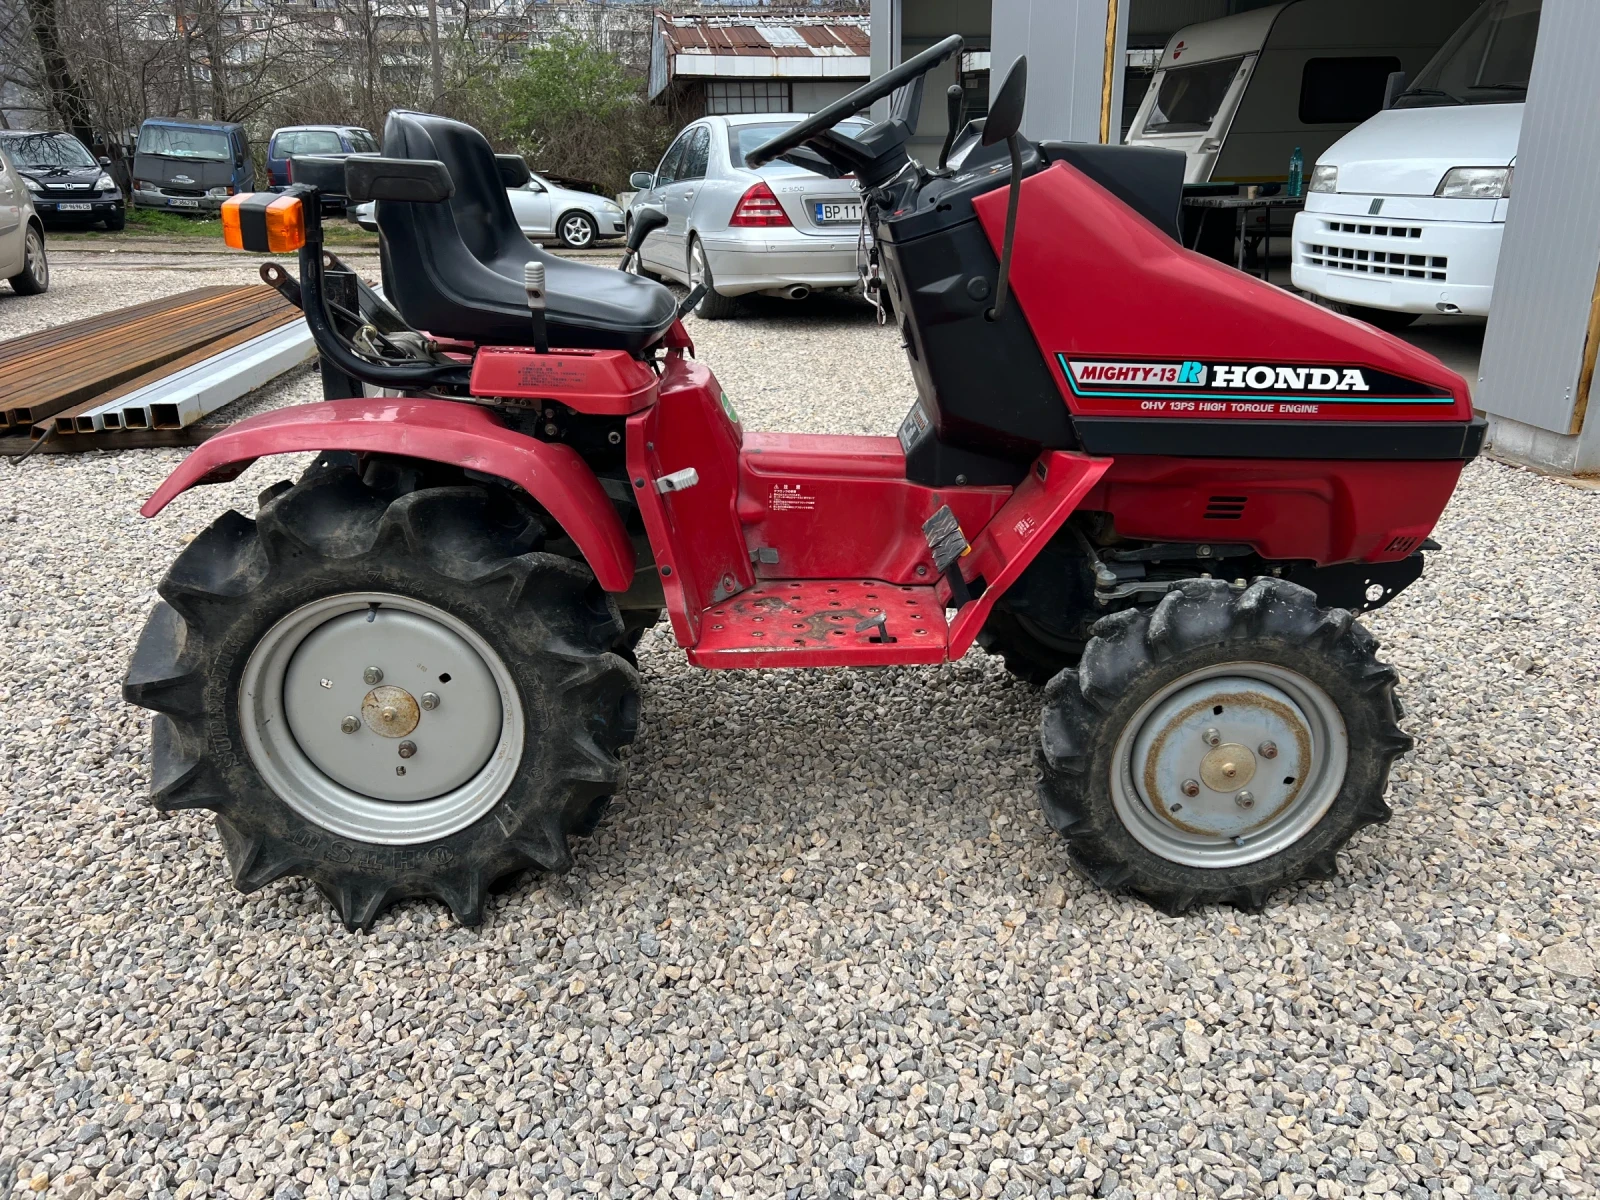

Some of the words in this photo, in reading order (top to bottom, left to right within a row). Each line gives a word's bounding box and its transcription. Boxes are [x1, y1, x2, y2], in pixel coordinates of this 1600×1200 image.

[824, 205, 840, 219] BP
[1211, 365, 1369, 391] HONDA
[1140, 401, 1166, 410] OHV
[1169, 401, 1195, 411] 13PS
[1198, 402, 1227, 412] HIGH
[1230, 402, 1274, 413] TORQUE
[1279, 403, 1319, 414] ENGINE
